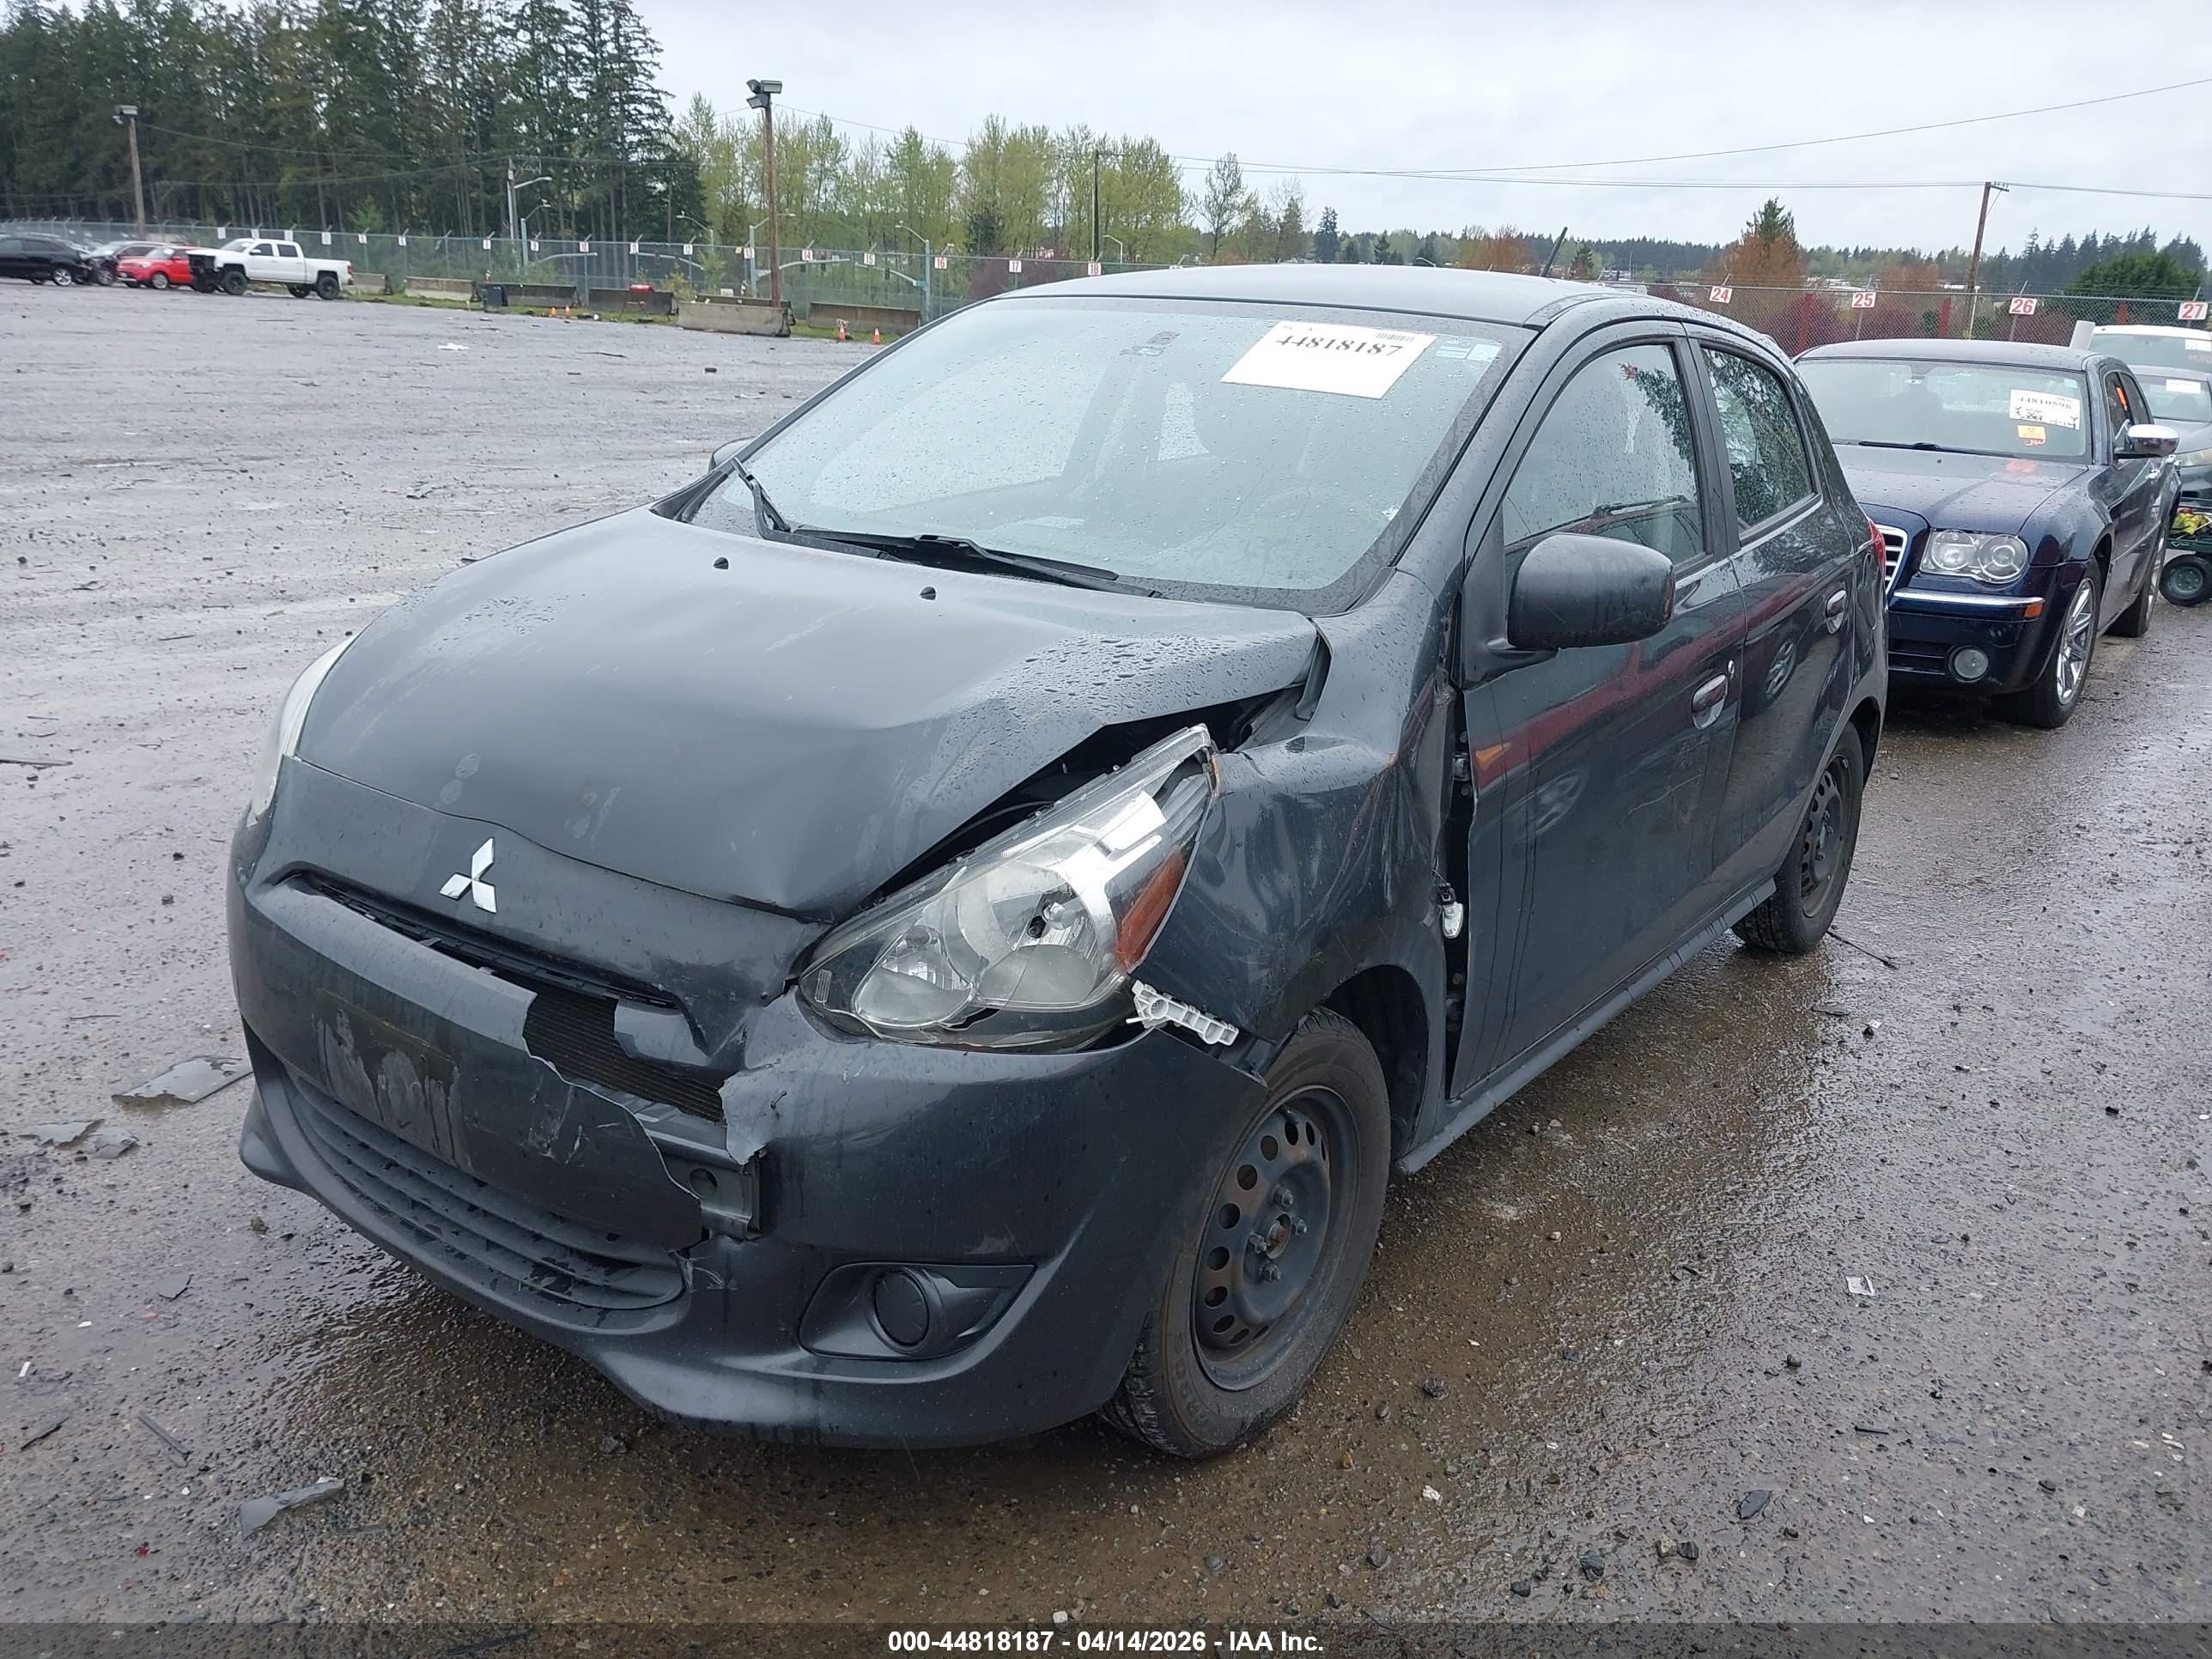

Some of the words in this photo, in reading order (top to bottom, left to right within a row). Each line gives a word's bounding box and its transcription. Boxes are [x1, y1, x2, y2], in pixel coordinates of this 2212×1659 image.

[804, 250, 811, 260] 14
[865, 253, 874, 264] 15
[936, 257, 946, 269] 16
[1012, 260, 1020, 272] 17
[1090, 263, 1100, 275] 18
[1711, 288, 1729, 302] 24
[1853, 293, 1874, 307] 25
[2011, 299, 2033, 313] 26
[2182, 303, 2203, 319] 27
[1275, 335, 1404, 356] 44818187
